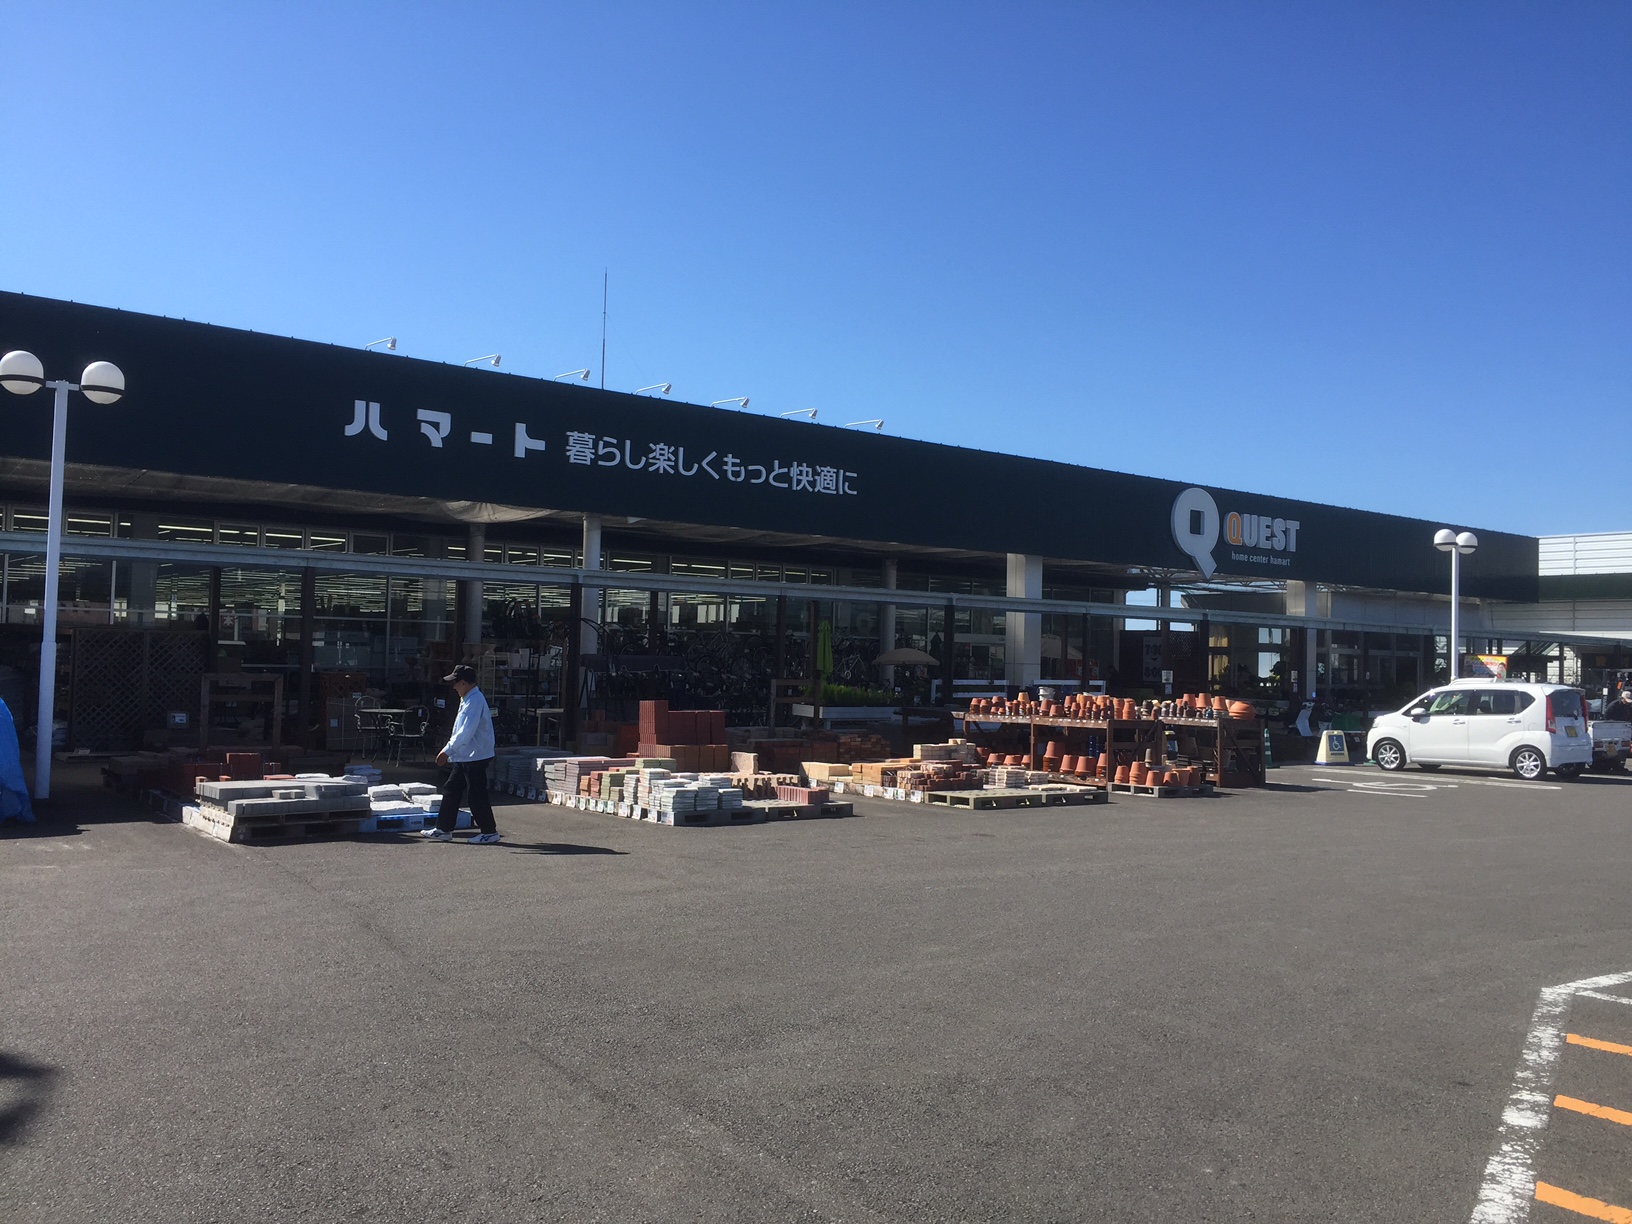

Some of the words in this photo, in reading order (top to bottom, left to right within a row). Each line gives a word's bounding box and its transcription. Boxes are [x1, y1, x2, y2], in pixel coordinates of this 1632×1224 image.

[565, 431, 858, 496] 暮らし楽しくもっと快適に
[1224, 511, 1300, 552] QUEST
[1231, 550, 1248, 562] home
[1249, 554, 1269, 564] center
[1270, 555, 1291, 567] hamart
